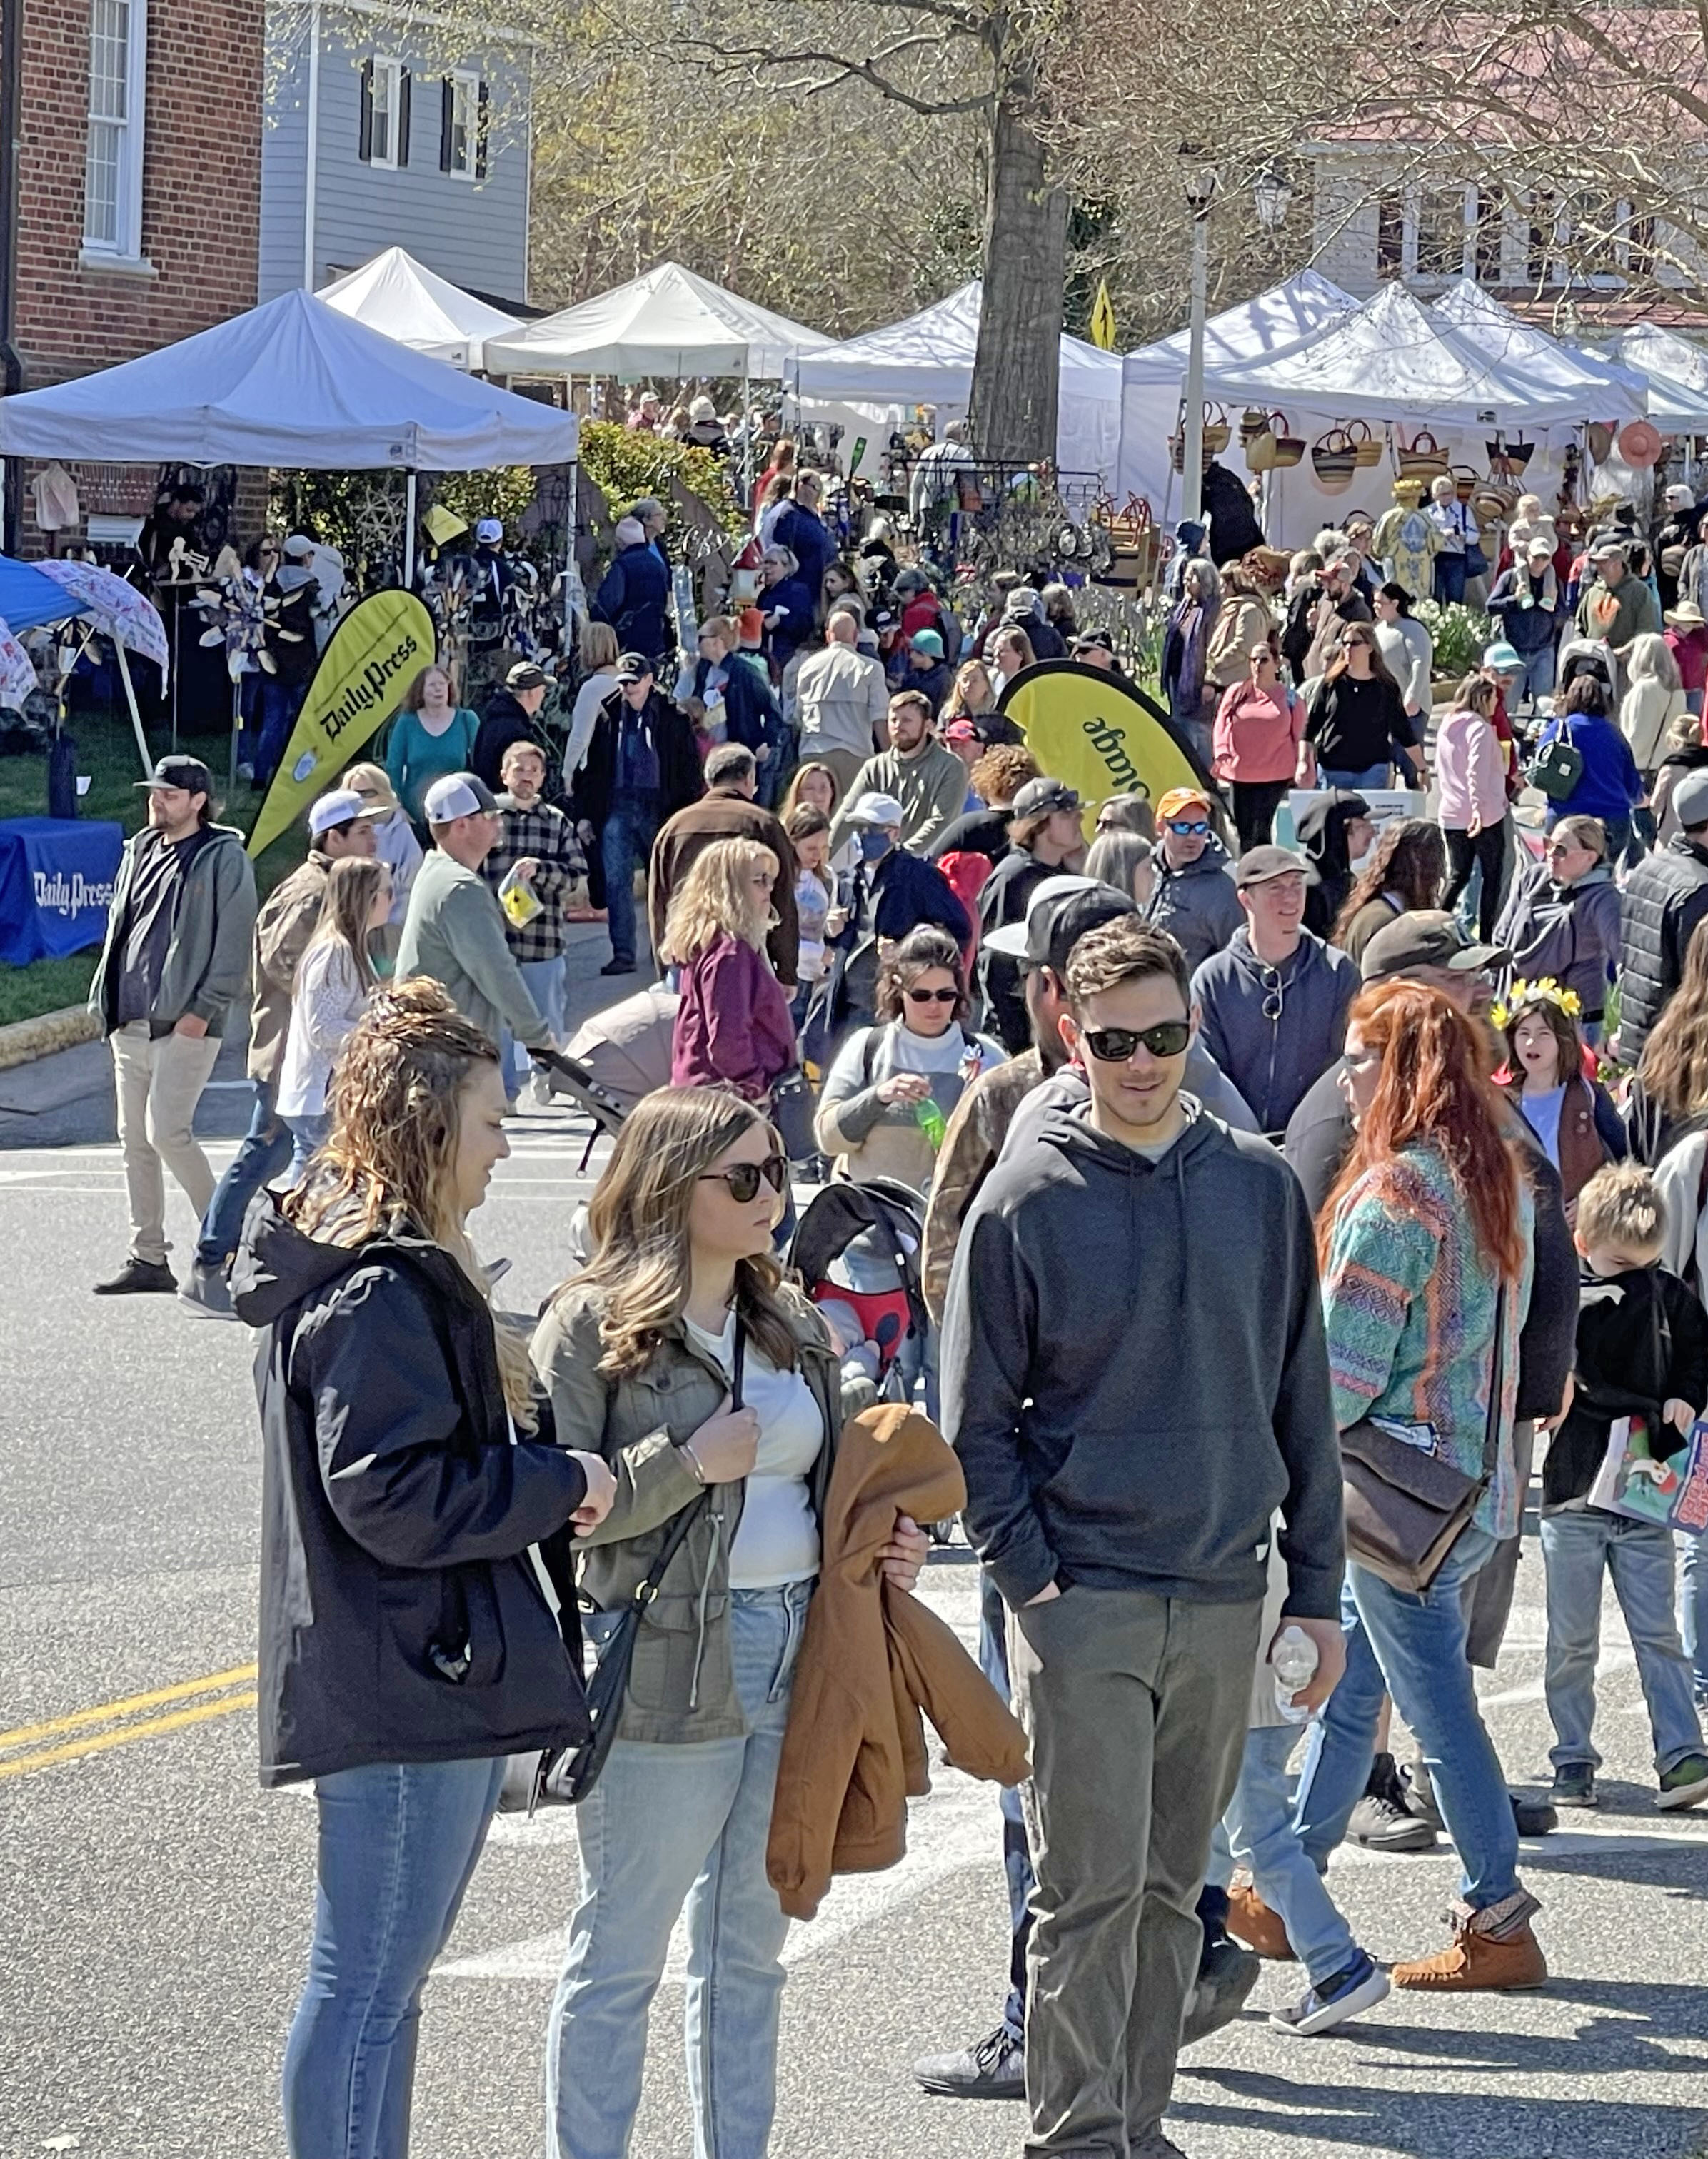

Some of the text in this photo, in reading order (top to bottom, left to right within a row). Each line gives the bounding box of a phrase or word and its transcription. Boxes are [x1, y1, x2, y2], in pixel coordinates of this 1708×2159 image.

[320, 635, 417, 744] Daily Press
[34, 871, 114, 920] Daily Press
